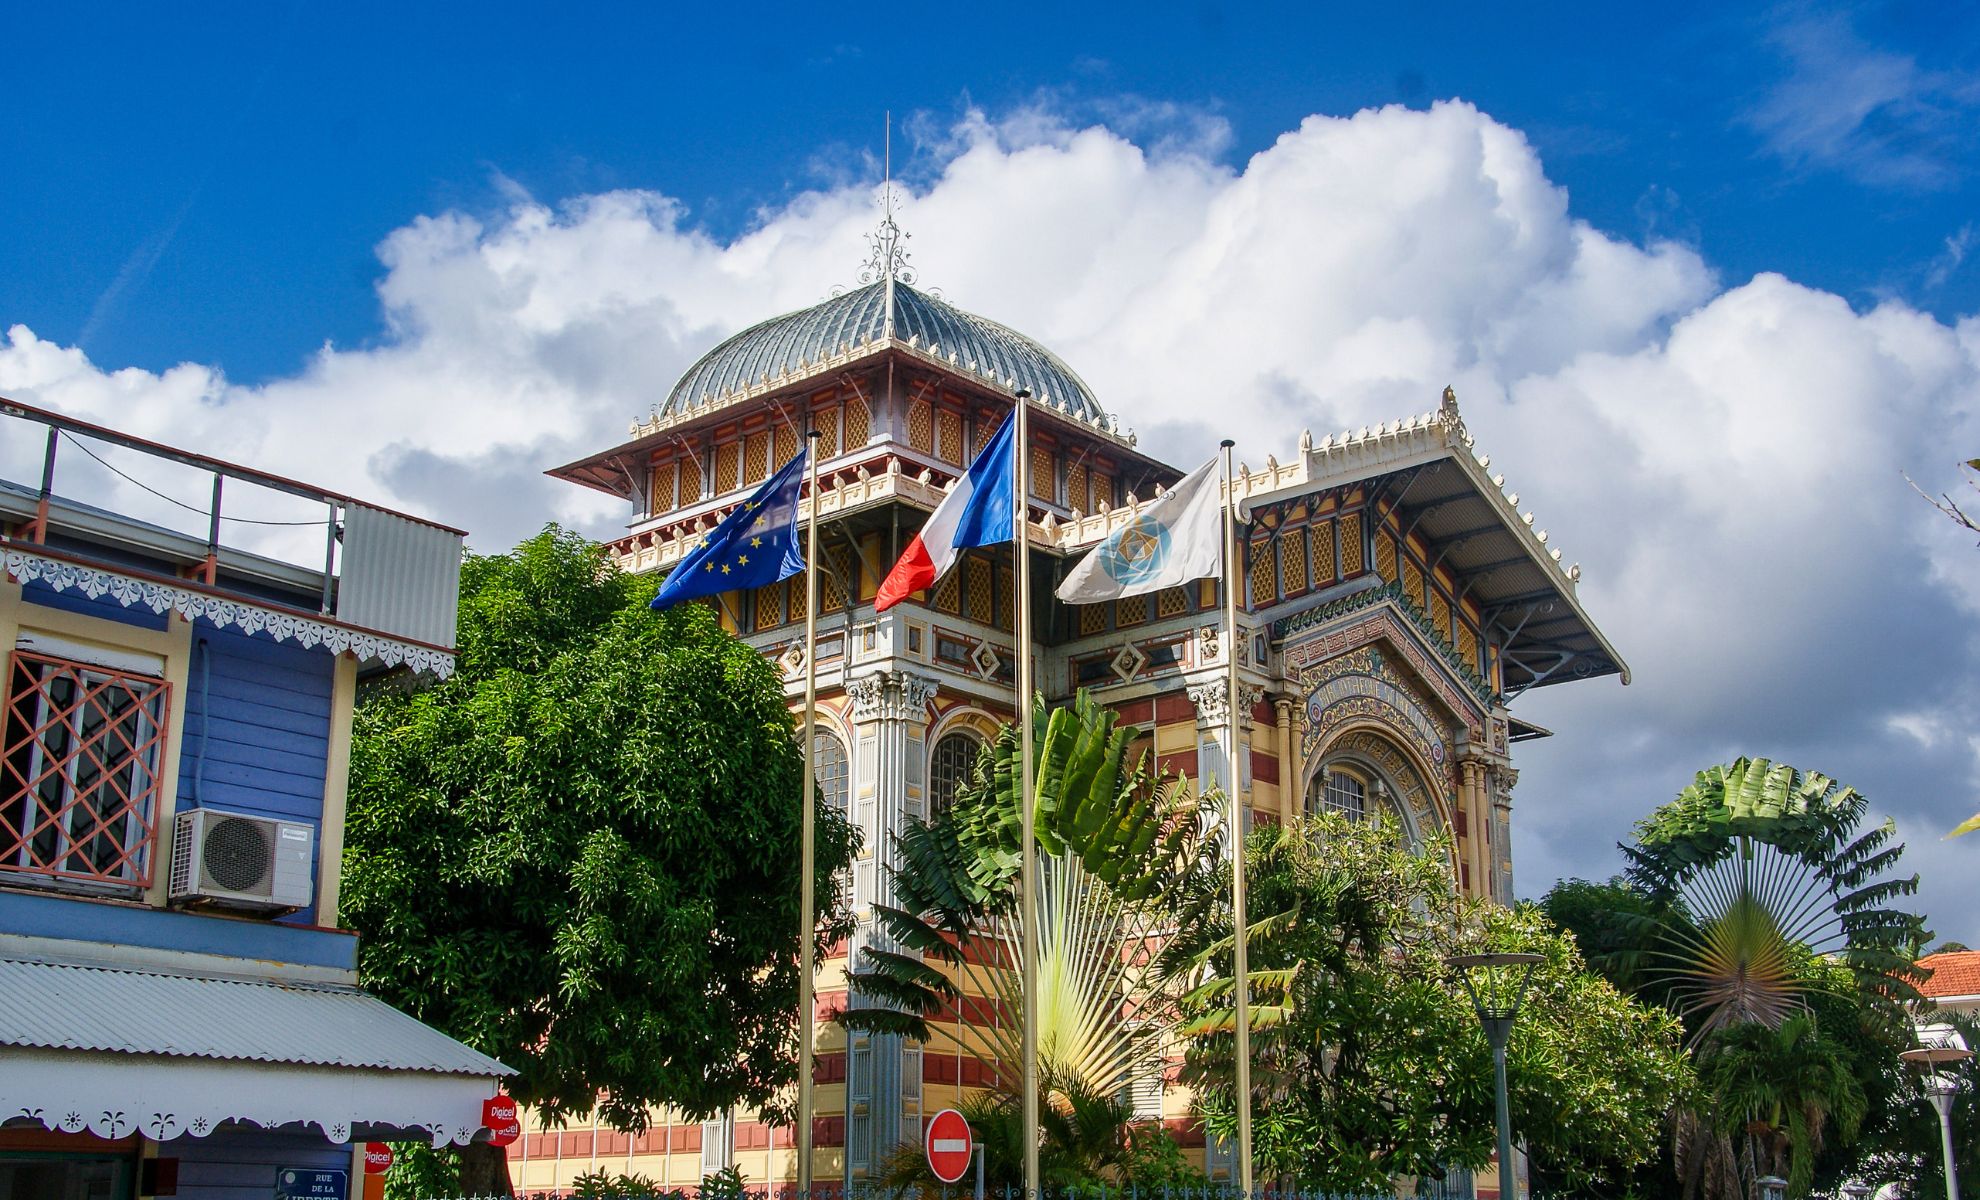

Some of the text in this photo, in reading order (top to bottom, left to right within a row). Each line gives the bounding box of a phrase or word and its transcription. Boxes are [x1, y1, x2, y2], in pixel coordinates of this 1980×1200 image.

[491, 1106, 515, 1120] Digicel
[315, 1174, 333, 1182] RUE
[324, 1185, 334, 1193] LA
